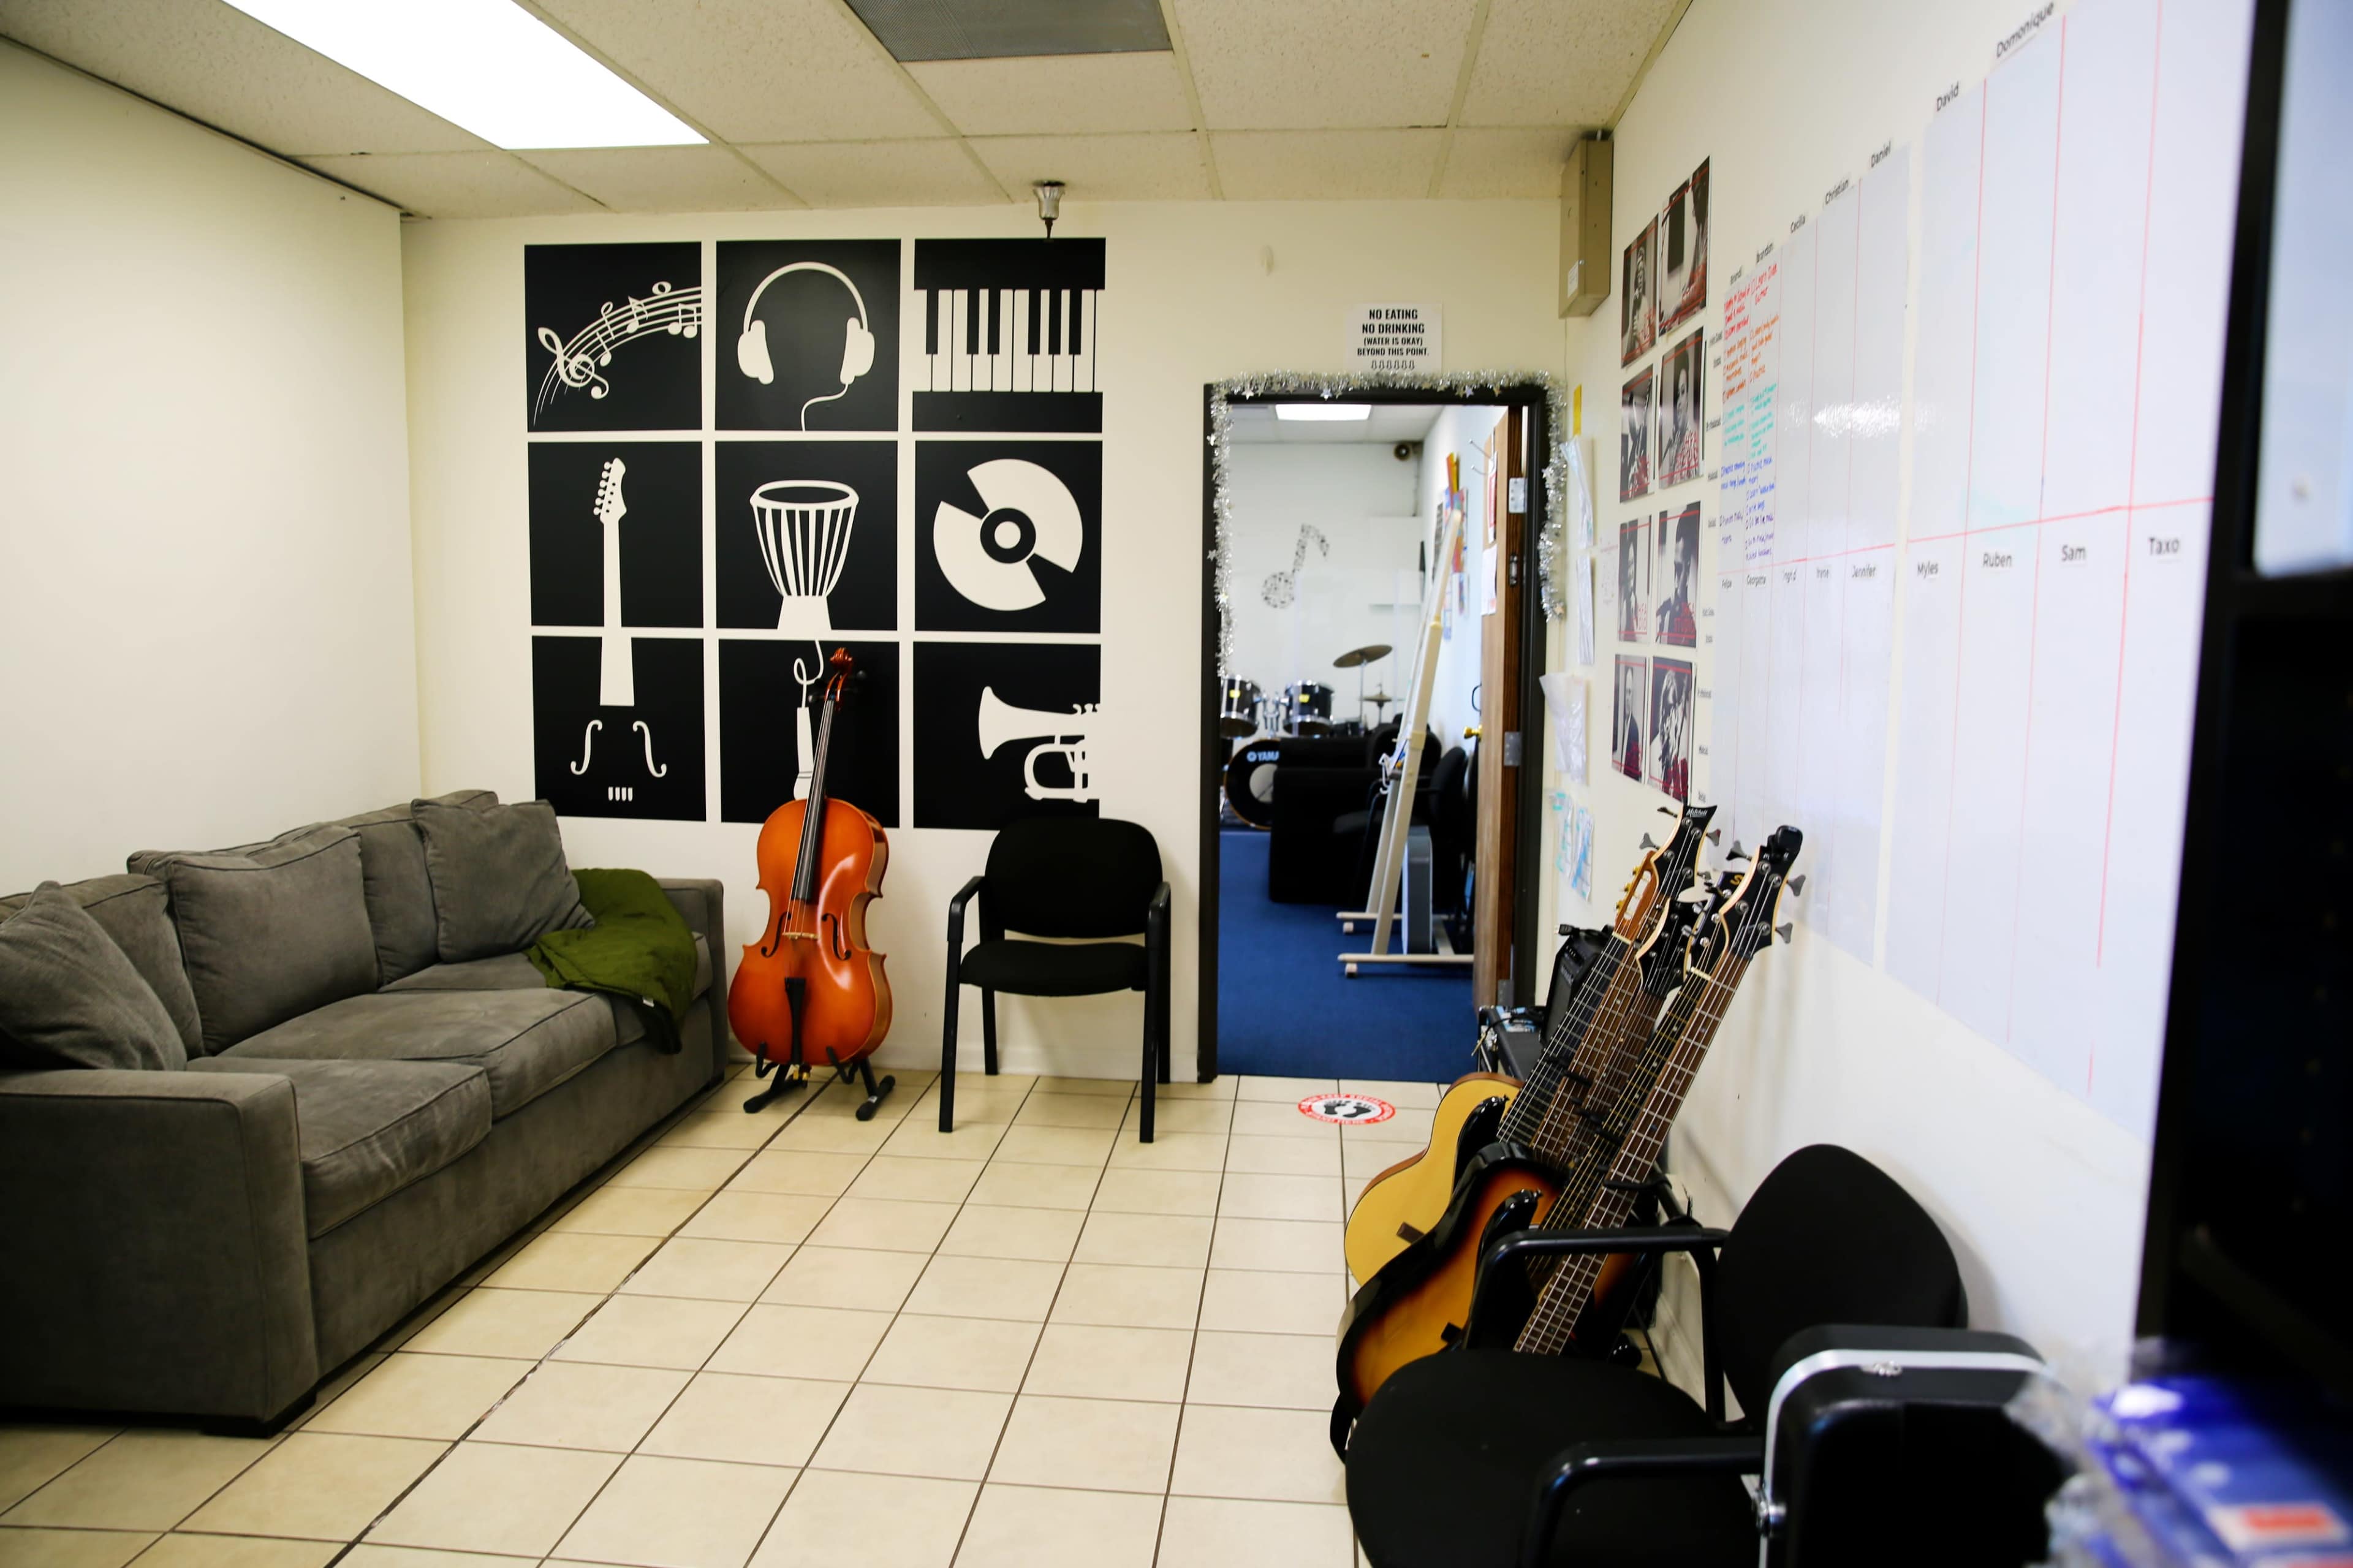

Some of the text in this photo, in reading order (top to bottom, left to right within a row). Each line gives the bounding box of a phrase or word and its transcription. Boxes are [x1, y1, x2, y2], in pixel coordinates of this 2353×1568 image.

[1996, 2, 2054, 58] Domonique
[1936, 81, 1959, 112] David
[1871, 140, 1891, 168] Daniel
[1825, 178, 1849, 205] Christian
[1369, 309, 1418, 319] NO EATING
[1362, 324, 1425, 334] NO DRINKING
[1364, 337, 1390, 346] (WATER
[1401, 337, 1423, 346] OKAY)
[1357, 347, 1430, 356] BEYOND THIS POINT.
[2061, 545, 2086, 561] Sam
[2150, 537, 2180, 555] Taxo
[1983, 553, 2012, 568] Ruben
[1917, 561, 1939, 579] Myles
